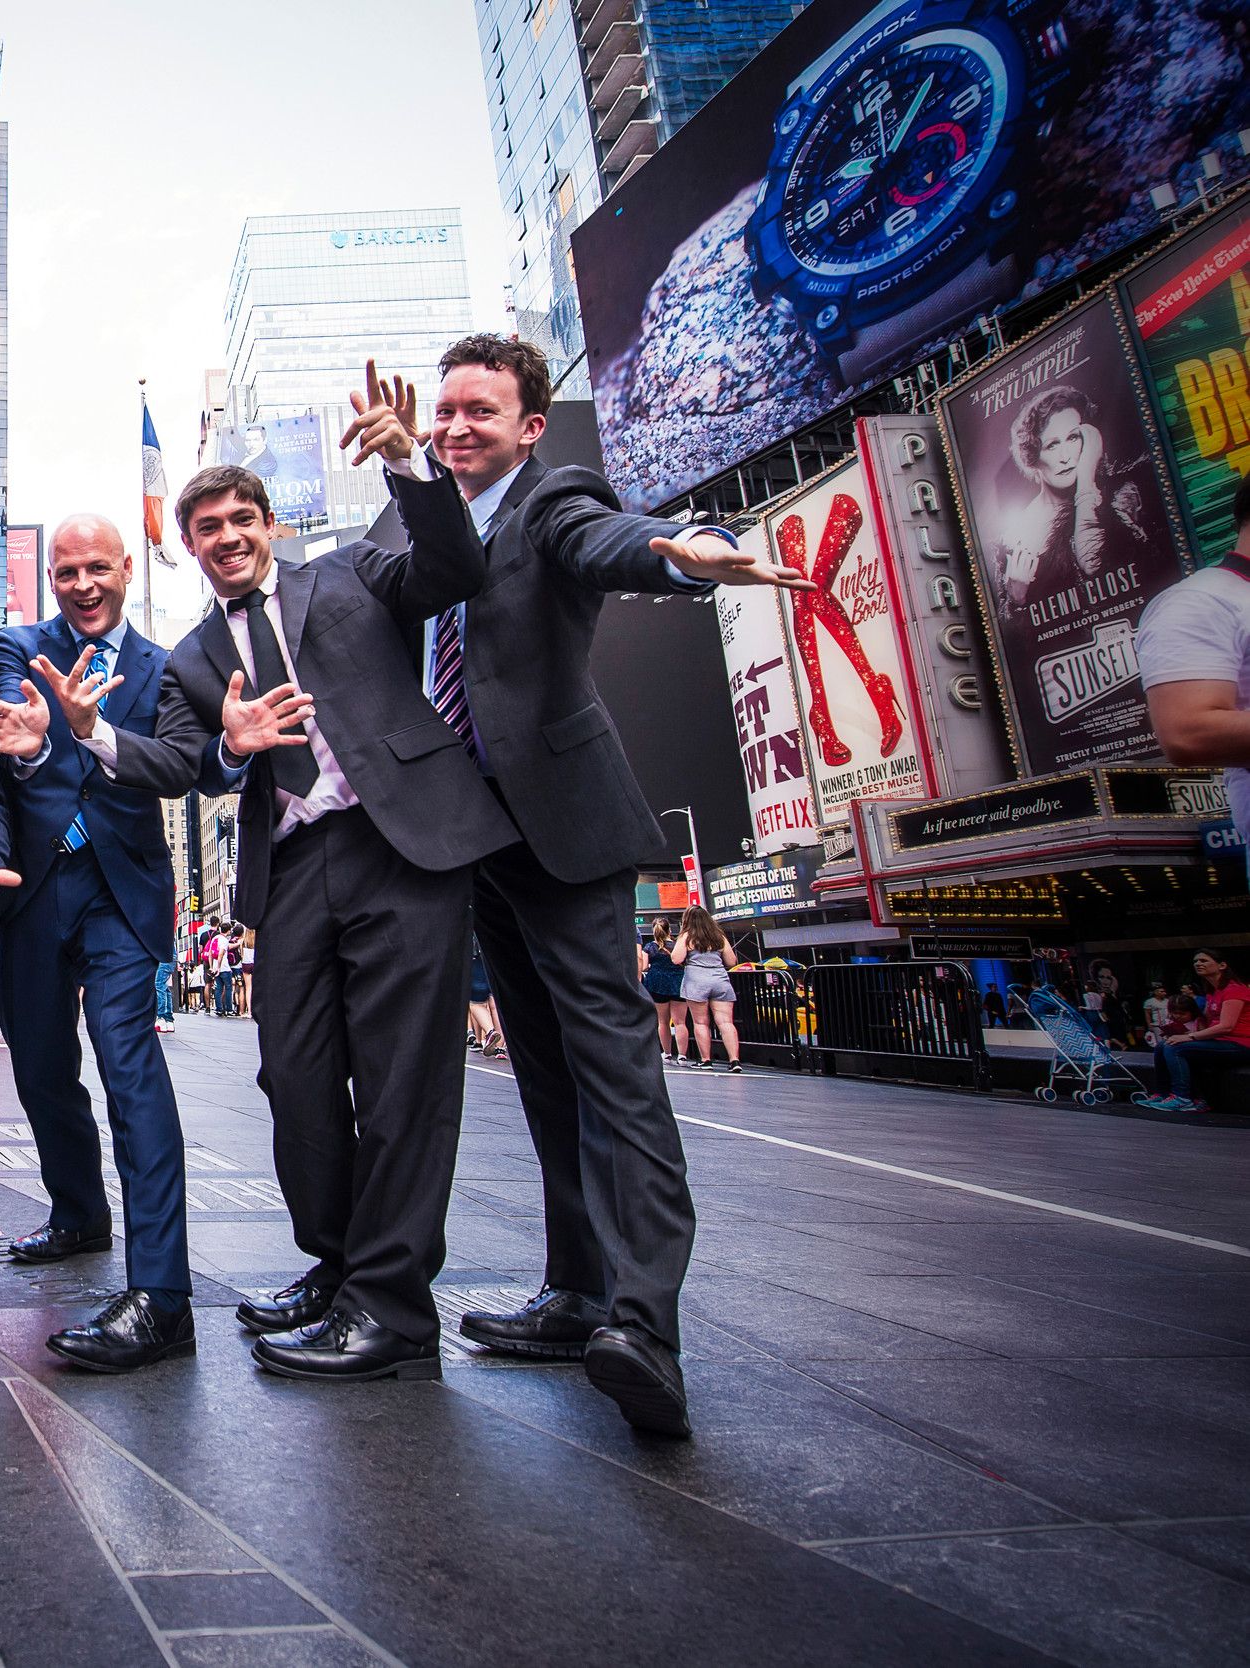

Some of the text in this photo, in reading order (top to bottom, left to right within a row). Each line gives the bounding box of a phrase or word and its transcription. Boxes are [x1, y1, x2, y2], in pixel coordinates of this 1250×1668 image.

[812, 10, 917, 103] G-SHOCK
[950, 84, 982, 120] 3
[782, 114, 812, 164] ADJUST
[805, 199, 829, 230] 9
[884, 207, 917, 236] 6
[355, 229, 448, 246] BARCLAYS
[857, 224, 966, 300] PROTECTION
[1157, 289, 1184, 314] New
[1183, 263, 1216, 296] York
[1213, 234, 1250, 268] Time
[806, 280, 842, 293] MODE
[269, 479, 322, 499] TOM
[899, 433, 982, 709] PALACE
[1029, 563, 1141, 627] GLENN CLOSE
[1037, 596, 1145, 642] ANDREW LLOYD WEBBER'S
[1052, 640, 1129, 709] SUNSET
[734, 685, 771, 748] ET
[743, 728, 805, 795] WN
[1055, 748, 1090, 763] STRICTLY
[1092, 740, 1125, 754] LIMITED
[820, 773, 856, 795] WINNER!
[864, 762, 887, 782] TONY
[890, 755, 918, 778] AWAR
[823, 774, 921, 805] INCLUDING BEST MUSIC
[922, 821, 935, 835] As
[944, 819, 957, 830] we
[959, 813, 988, 828] never
[988, 805, 1010, 821] said
[1011, 798, 1063, 822] goodbye.
[1179, 785, 1230, 813] SUNSE
[755, 797, 813, 841] NETFLIX
[738, 871, 768, 888] CENTER
[768, 869, 779, 884] OF
[779, 866, 797, 881] THE
[746, 884, 796, 904] FESTIVITIES!
